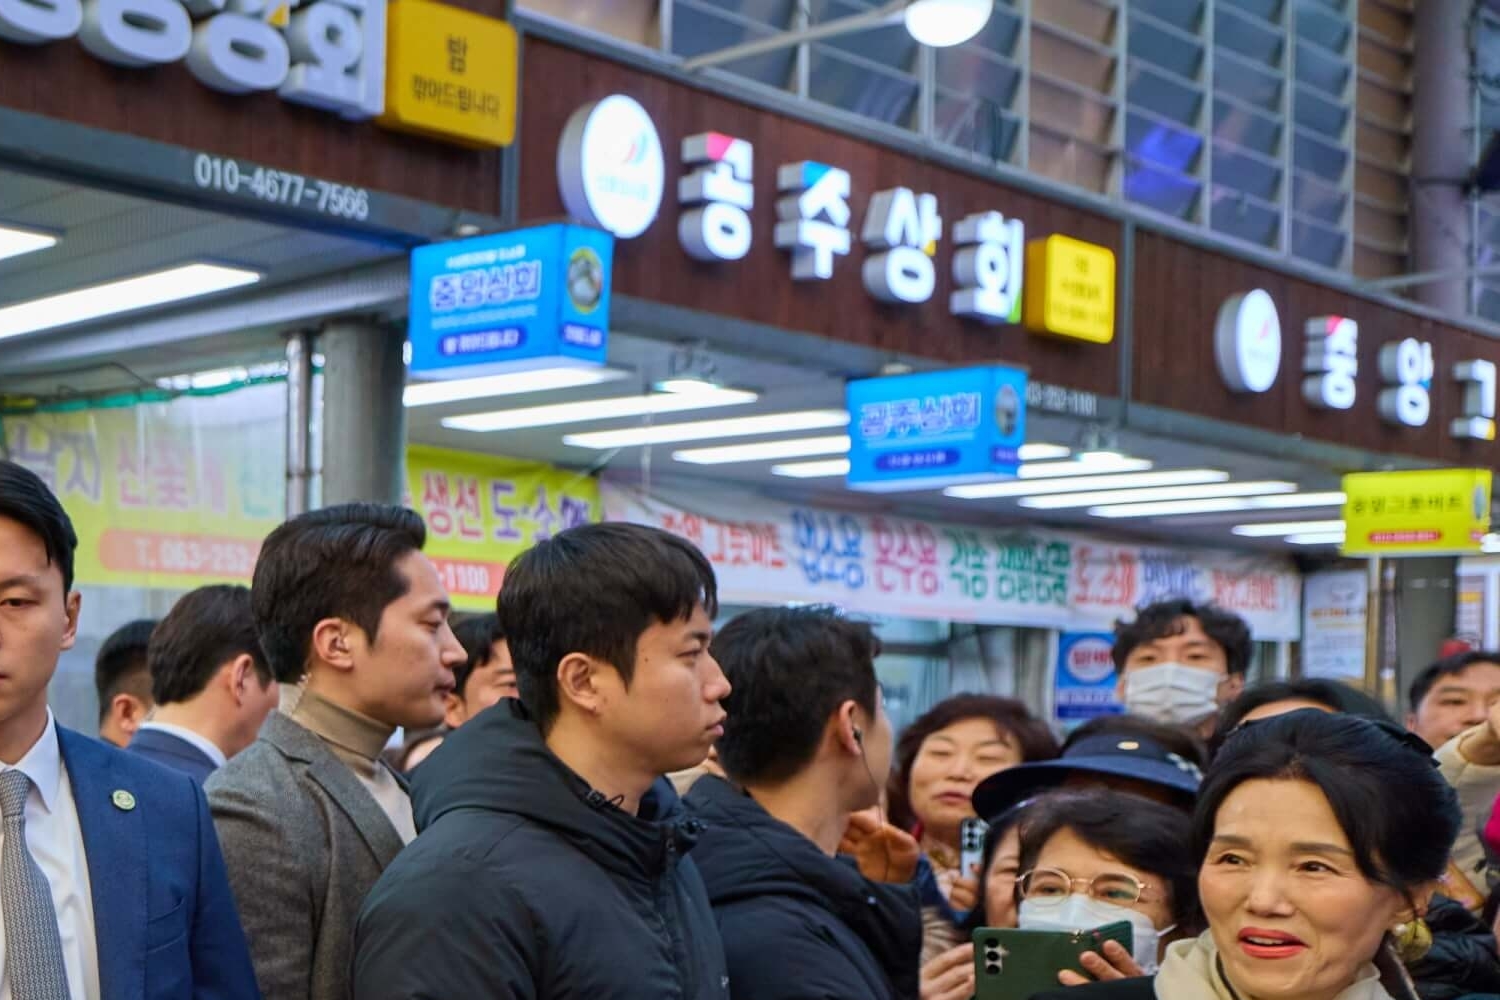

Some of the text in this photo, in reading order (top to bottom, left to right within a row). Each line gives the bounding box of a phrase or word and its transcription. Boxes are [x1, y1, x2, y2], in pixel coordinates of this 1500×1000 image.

[194, 152, 370, 222] 010-4677-7566
[679, 132, 1024, 324] 공주상회
[431, 261, 542, 311] 중앙상회
[860, 392, 981, 439] 공주상회
[422, 472, 484, 538] 생선
